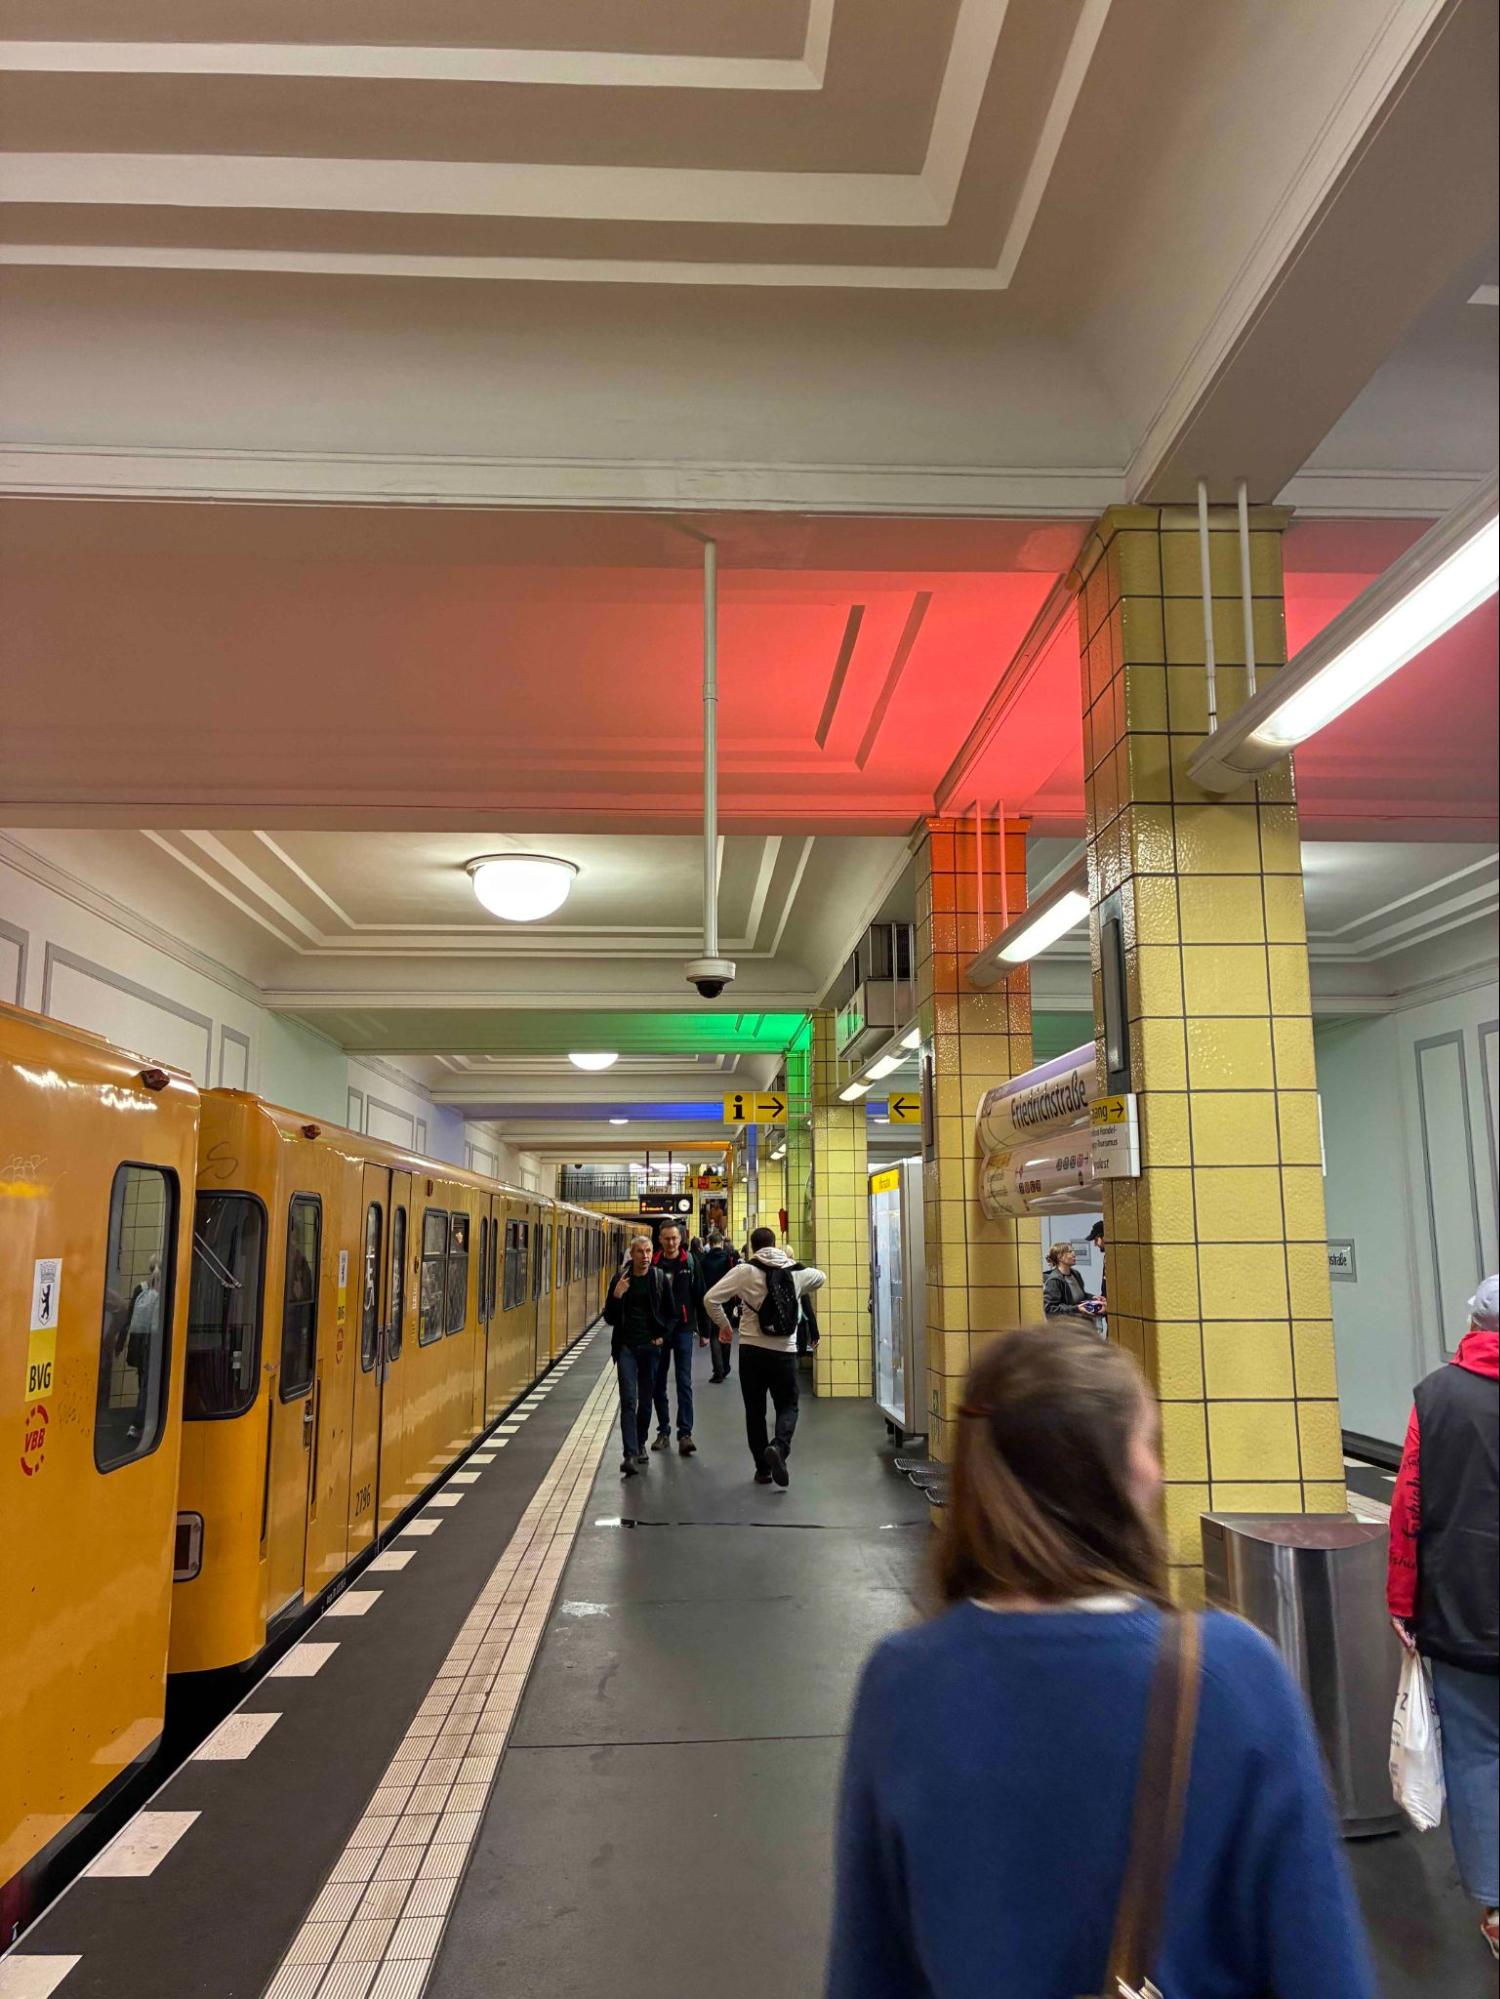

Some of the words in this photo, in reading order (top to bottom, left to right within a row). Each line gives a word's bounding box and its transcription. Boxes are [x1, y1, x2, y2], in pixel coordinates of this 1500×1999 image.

[1011, 1070, 1088, 1130] Friedrichstraße
[1328, 1251, 1347, 1266] straße
[29, 1361, 52, 1393] BVG
[24, 1427, 46, 1453] VBB
